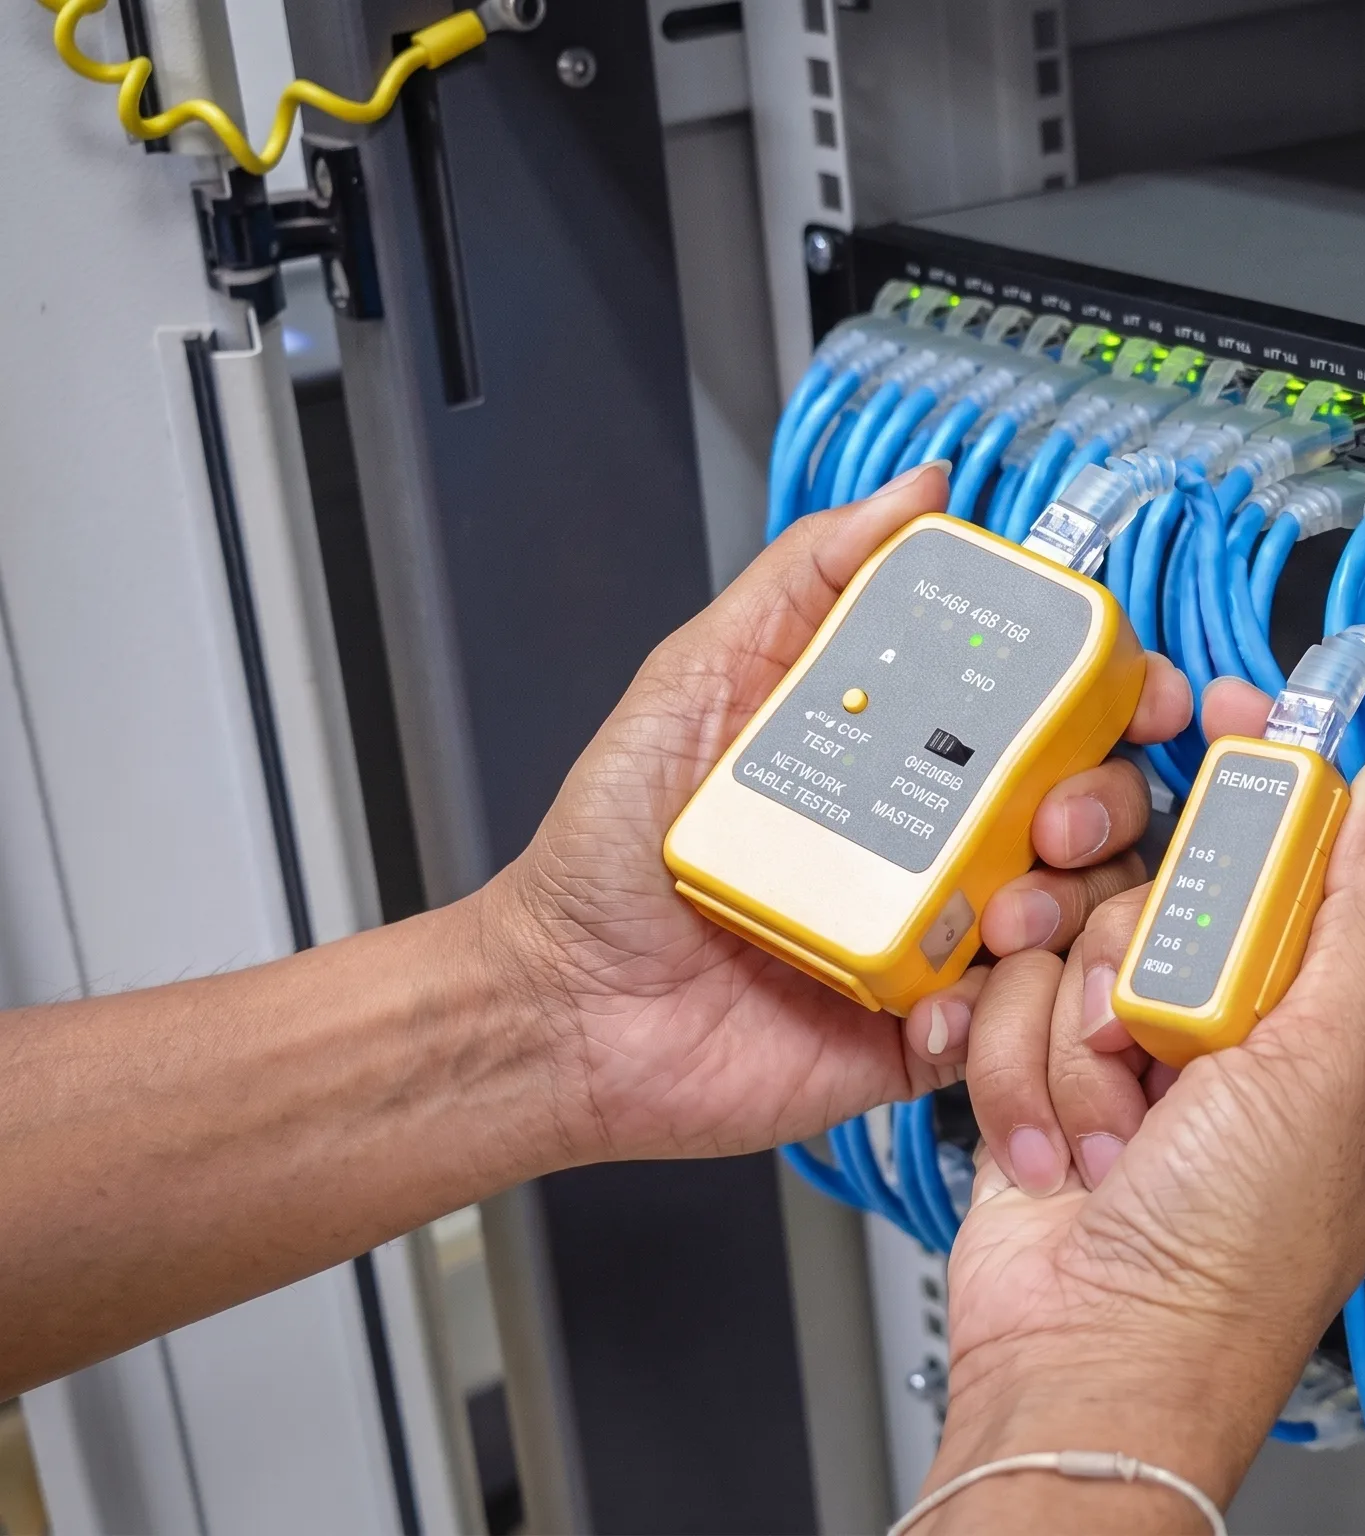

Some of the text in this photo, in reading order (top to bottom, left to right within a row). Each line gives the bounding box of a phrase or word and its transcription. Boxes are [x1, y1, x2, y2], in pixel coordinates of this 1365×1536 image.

[961, 668, 996, 692] SND
[802, 730, 845, 759] TEST
[837, 723, 873, 744] COF
[770, 751, 847, 797] NETWORK
[1216, 769, 1290, 797] REMOTE
[743, 762, 851, 825] CABLE TESTER
[890, 776, 950, 813] POWER
[871, 800, 935, 840] MASTER
